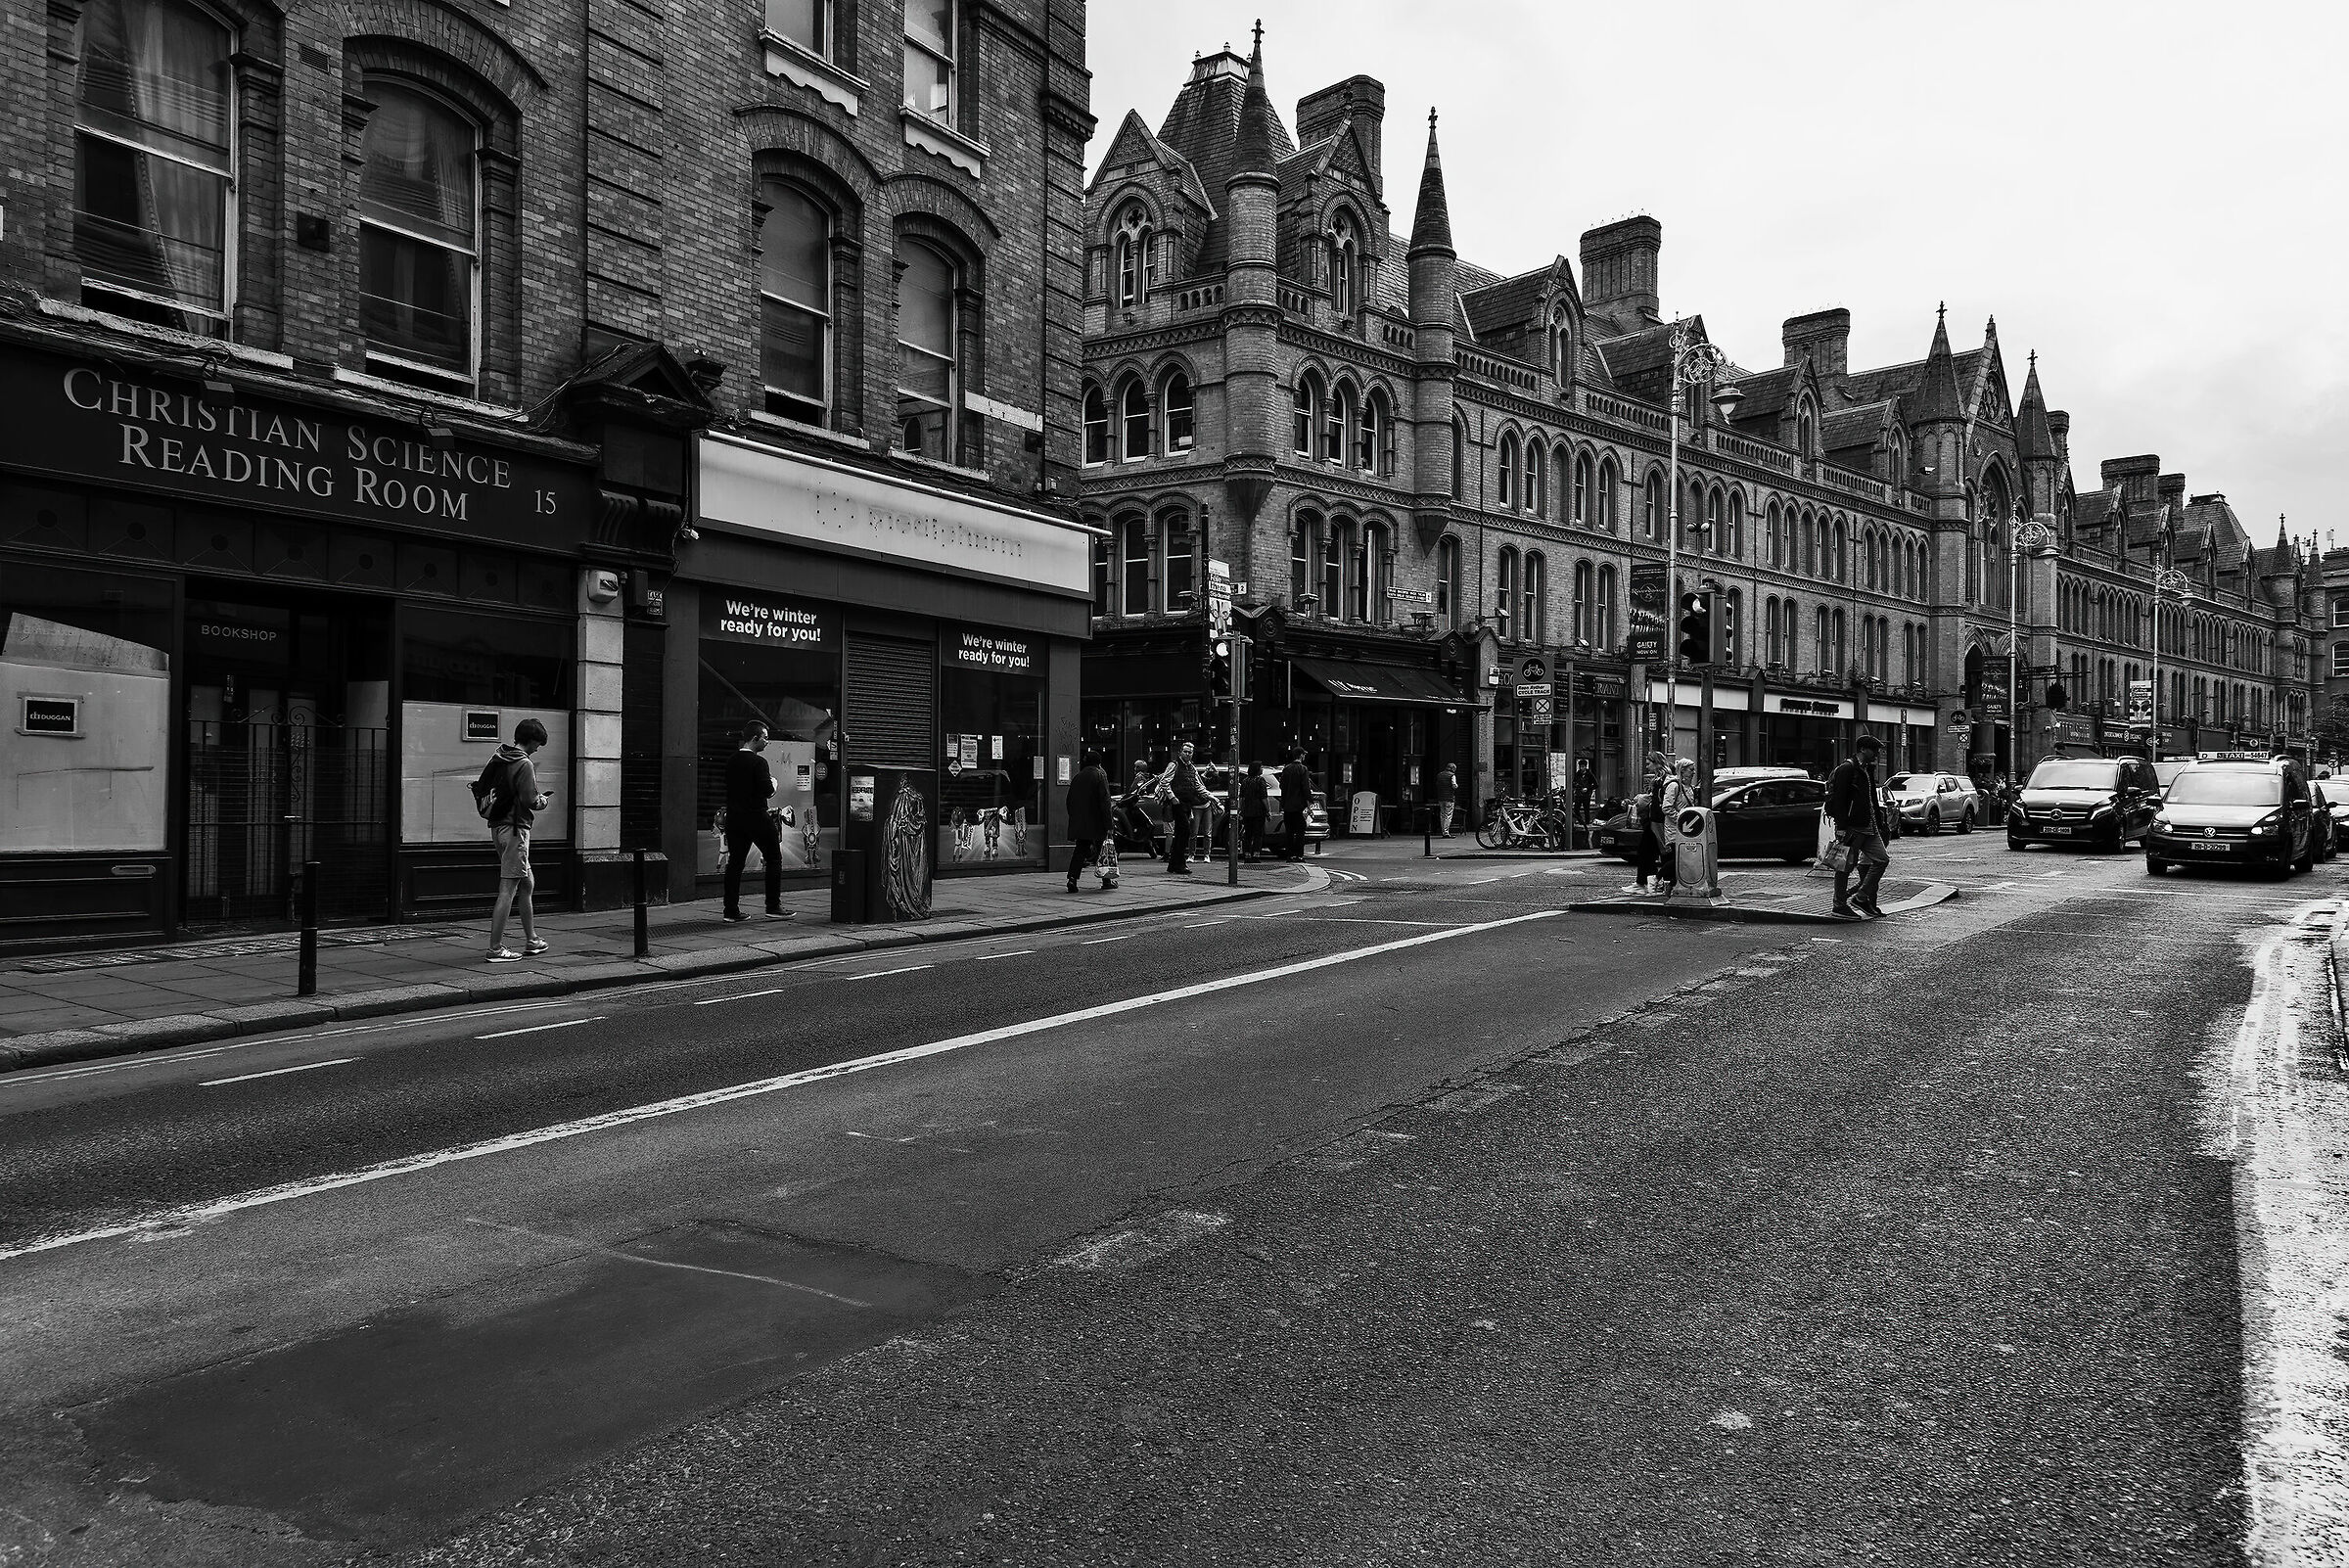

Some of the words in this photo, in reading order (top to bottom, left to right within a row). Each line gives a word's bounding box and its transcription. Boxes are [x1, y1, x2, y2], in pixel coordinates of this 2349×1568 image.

[63, 367, 323, 453] CHRISTIAN
[346, 425, 512, 489] SCIENCE
[117, 423, 336, 497] READING
[352, 466, 470, 522] ROOM
[534, 489, 557, 515] 15
[725, 599, 769, 619] We're
[772, 607, 817, 625] winter
[201, 624, 277, 642] BOOKSHOP
[720, 619, 763, 638] ready
[766, 622, 788, 638] for
[791, 627, 822, 642] you!
[962, 632, 992, 649] We're
[994, 639, 1027, 654] winter
[958, 649, 989, 665] ready
[990, 651, 1007, 665] for
[1008, 656, 1030, 668] you!
[1351, 798, 1360, 832] OPEN
